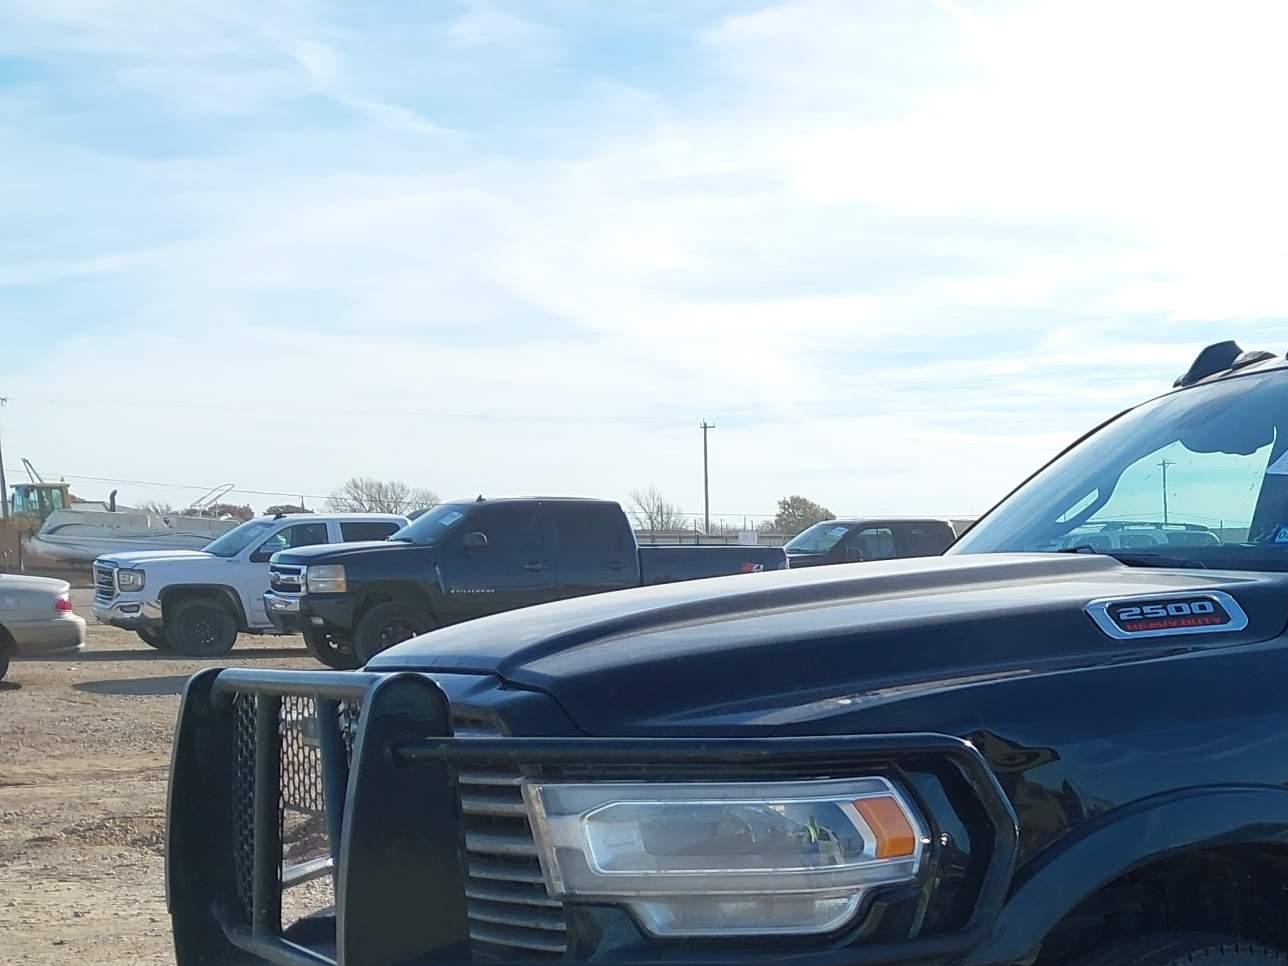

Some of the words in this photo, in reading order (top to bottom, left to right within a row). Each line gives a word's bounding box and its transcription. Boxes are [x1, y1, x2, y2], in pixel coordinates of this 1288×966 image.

[1116, 601, 1214, 621] 2500
[1126, 618, 1177, 630] HEAVY
[1181, 617, 1221, 626] DUTY
